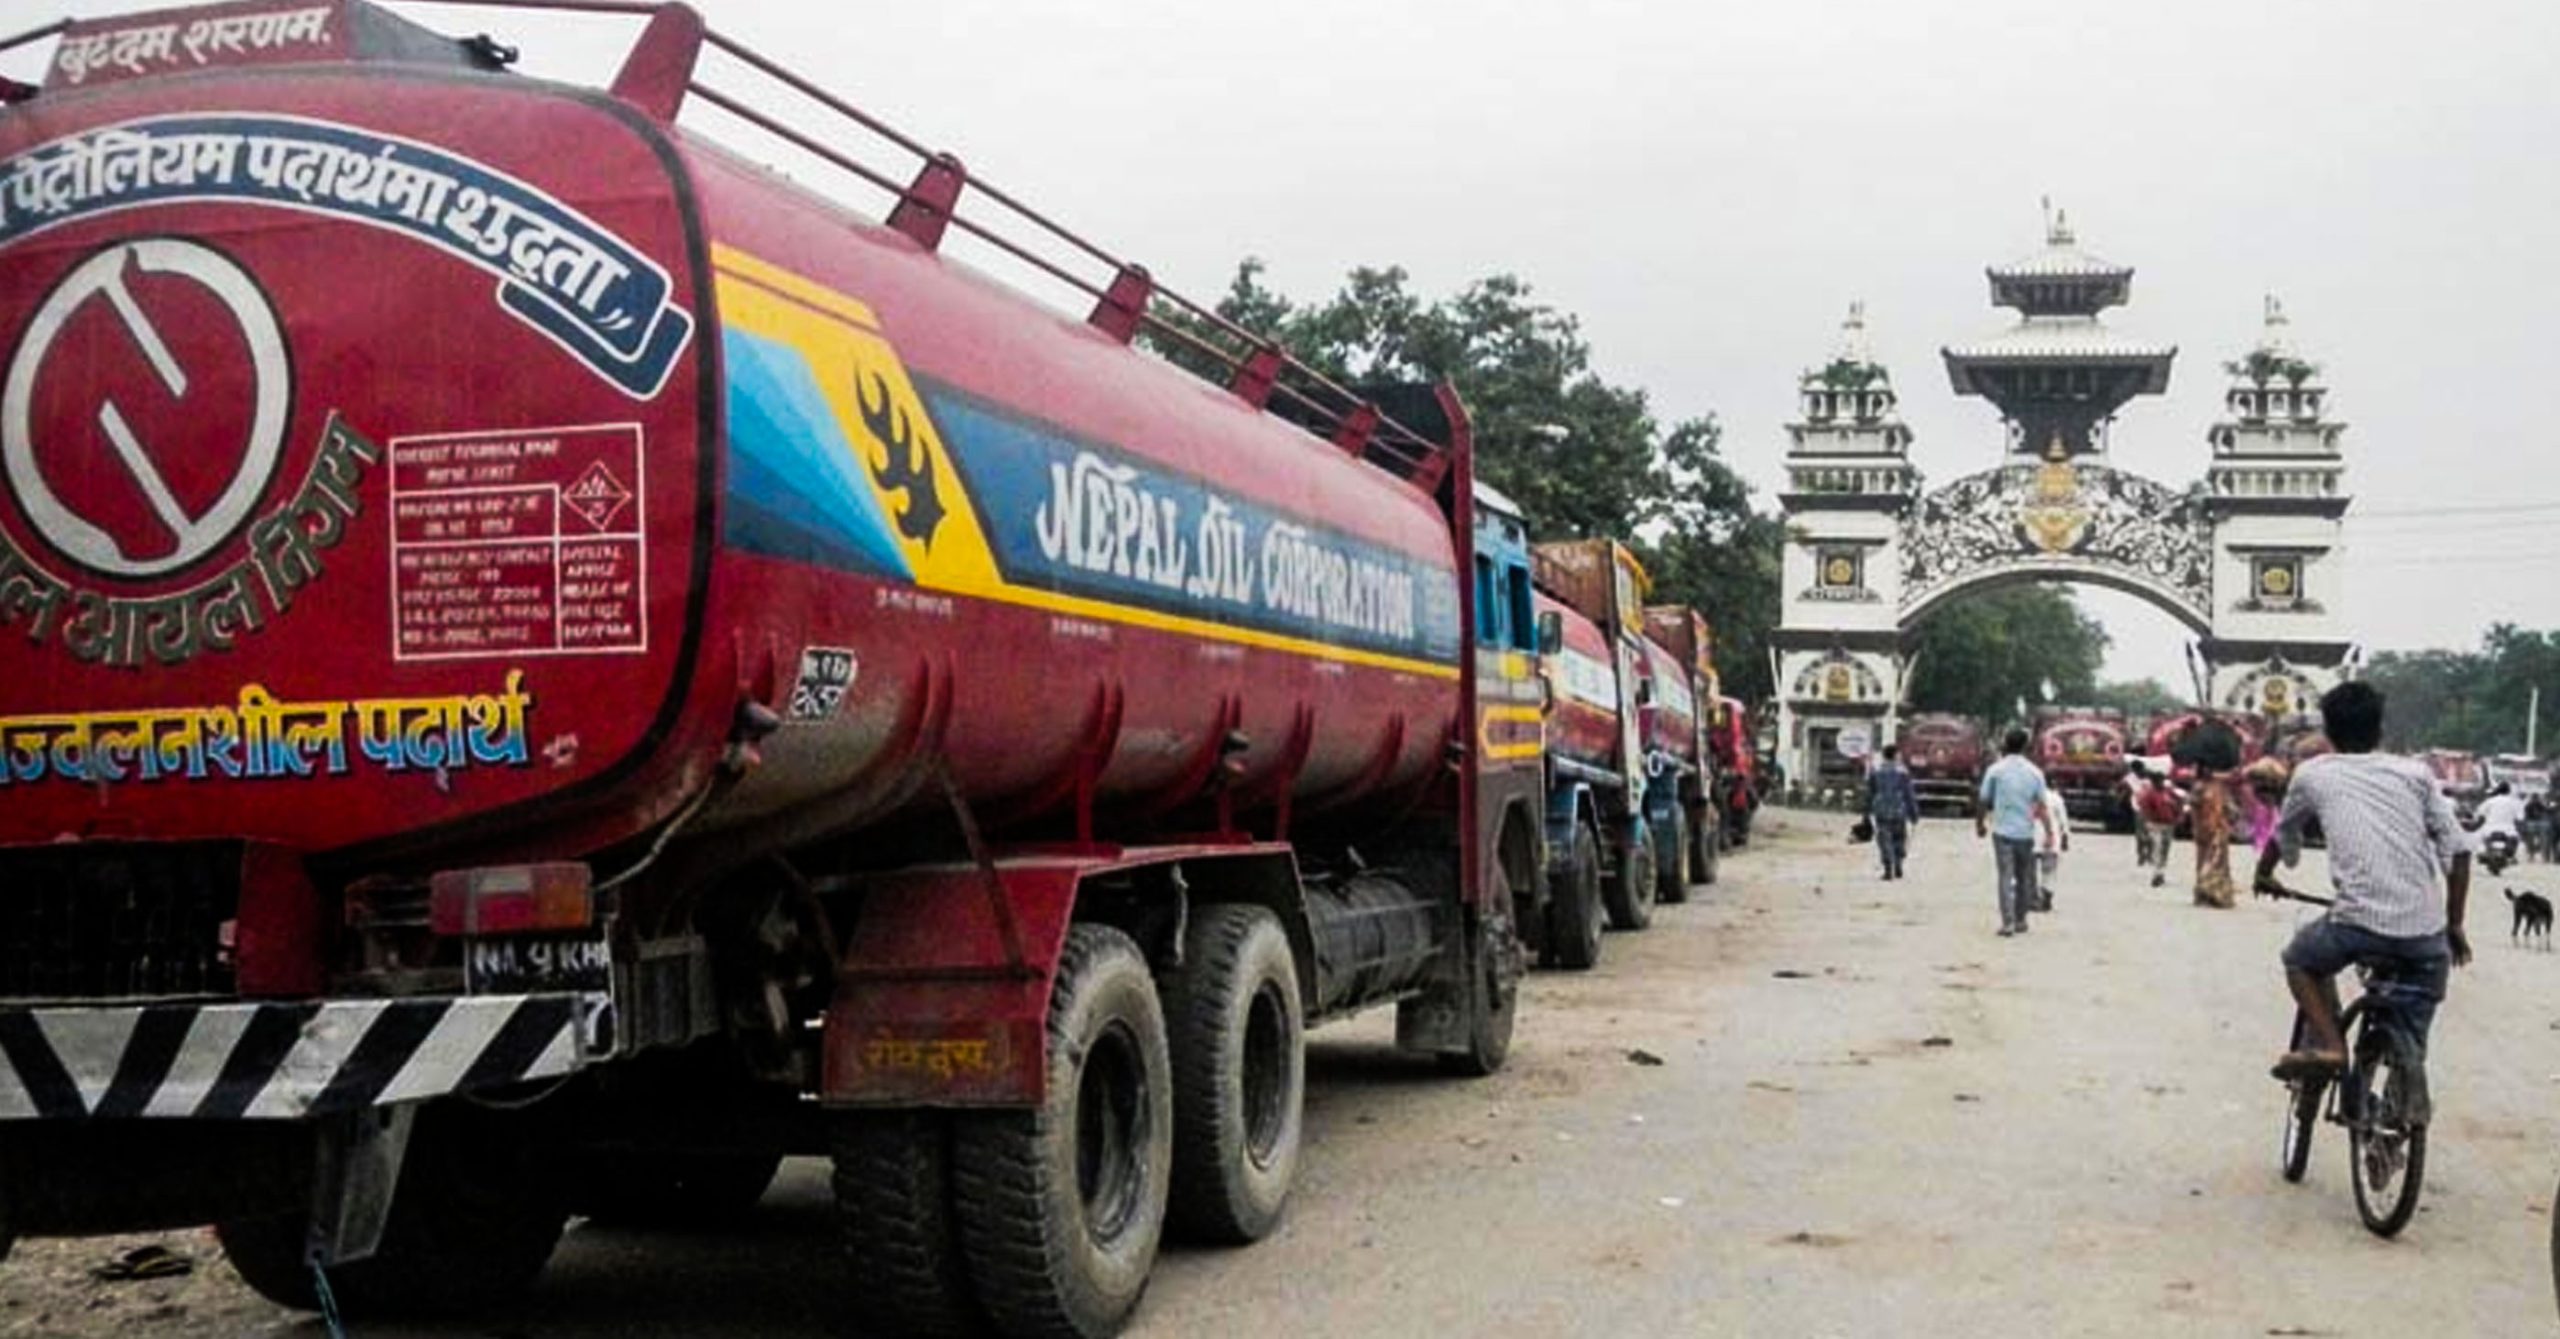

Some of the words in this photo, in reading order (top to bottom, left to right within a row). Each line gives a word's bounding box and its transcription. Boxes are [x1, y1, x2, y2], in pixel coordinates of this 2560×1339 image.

[1035, 451, 1189, 591] NEPAL
[1187, 493, 1256, 603] OIL
[1260, 519, 1415, 640] CORPORATION
[0, 684, 351, 786] ज्वलनशील
